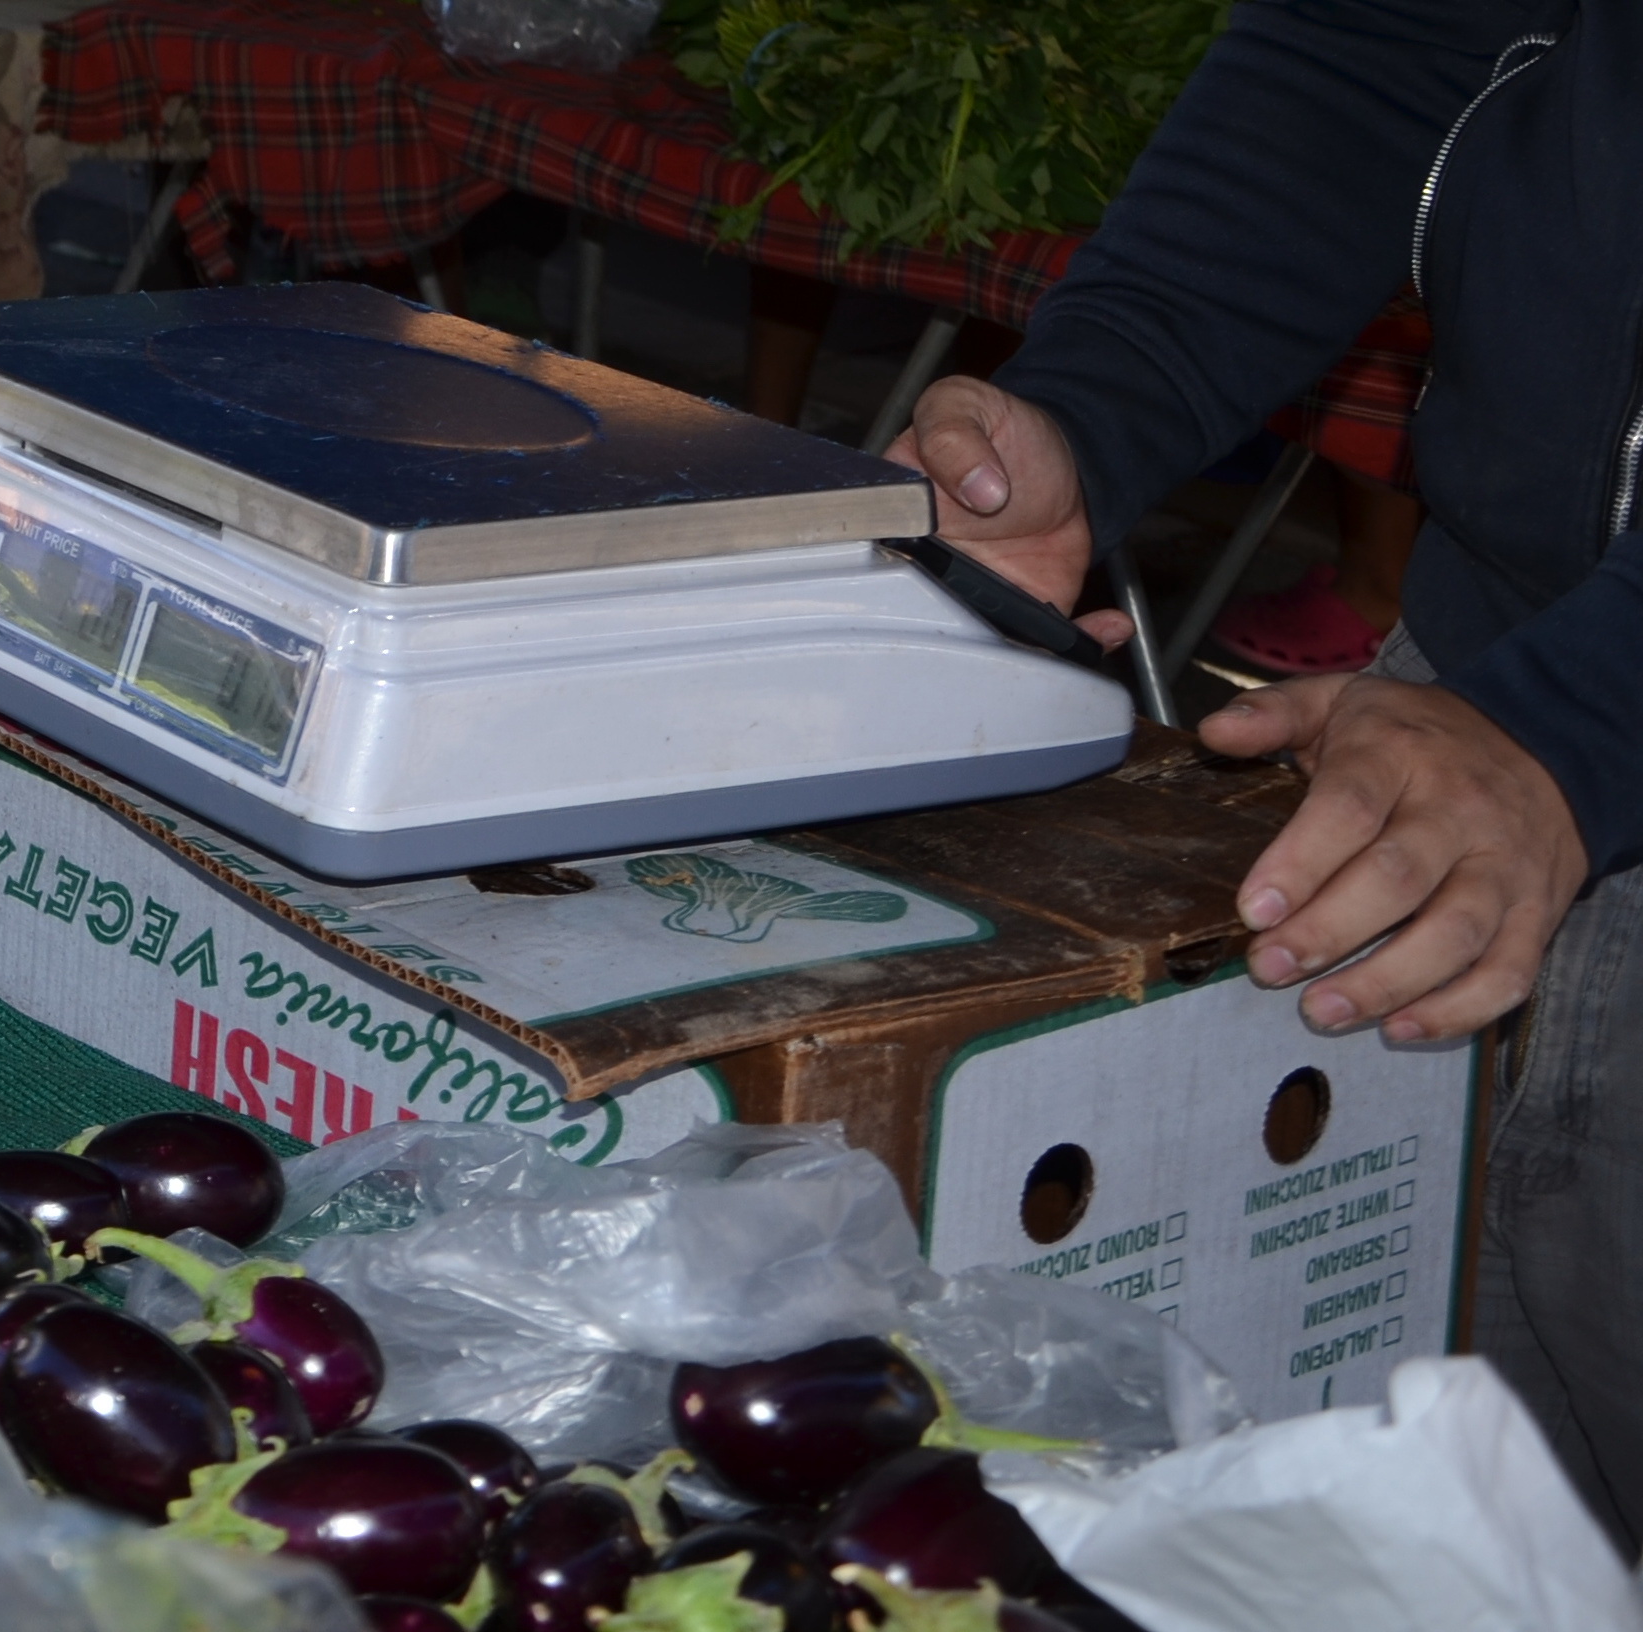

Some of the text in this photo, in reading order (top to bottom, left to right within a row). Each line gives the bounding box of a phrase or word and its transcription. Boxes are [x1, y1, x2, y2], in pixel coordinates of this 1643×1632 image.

[13, 516, 42, 544] UNIT
[43, 531, 81, 558] PRICE
[169, 587, 210, 614] TOTAL
[213, 606, 253, 631] PRICE
[171, 999, 420, 1146] RESH
[239, 950, 623, 1167] California
[1245, 1143, 1393, 1215] ITALIAN ZUCCHINI
[1096, 1220, 1160, 1261] ROUND
[1250, 1189, 1389, 1258] WHITE ZUCCHINI
[1307, 1234, 1386, 1283] SERRANO
[1303, 1279, 1382, 1329] ANAHEIM
[1290, 1325, 1379, 1378] JALAPENO
